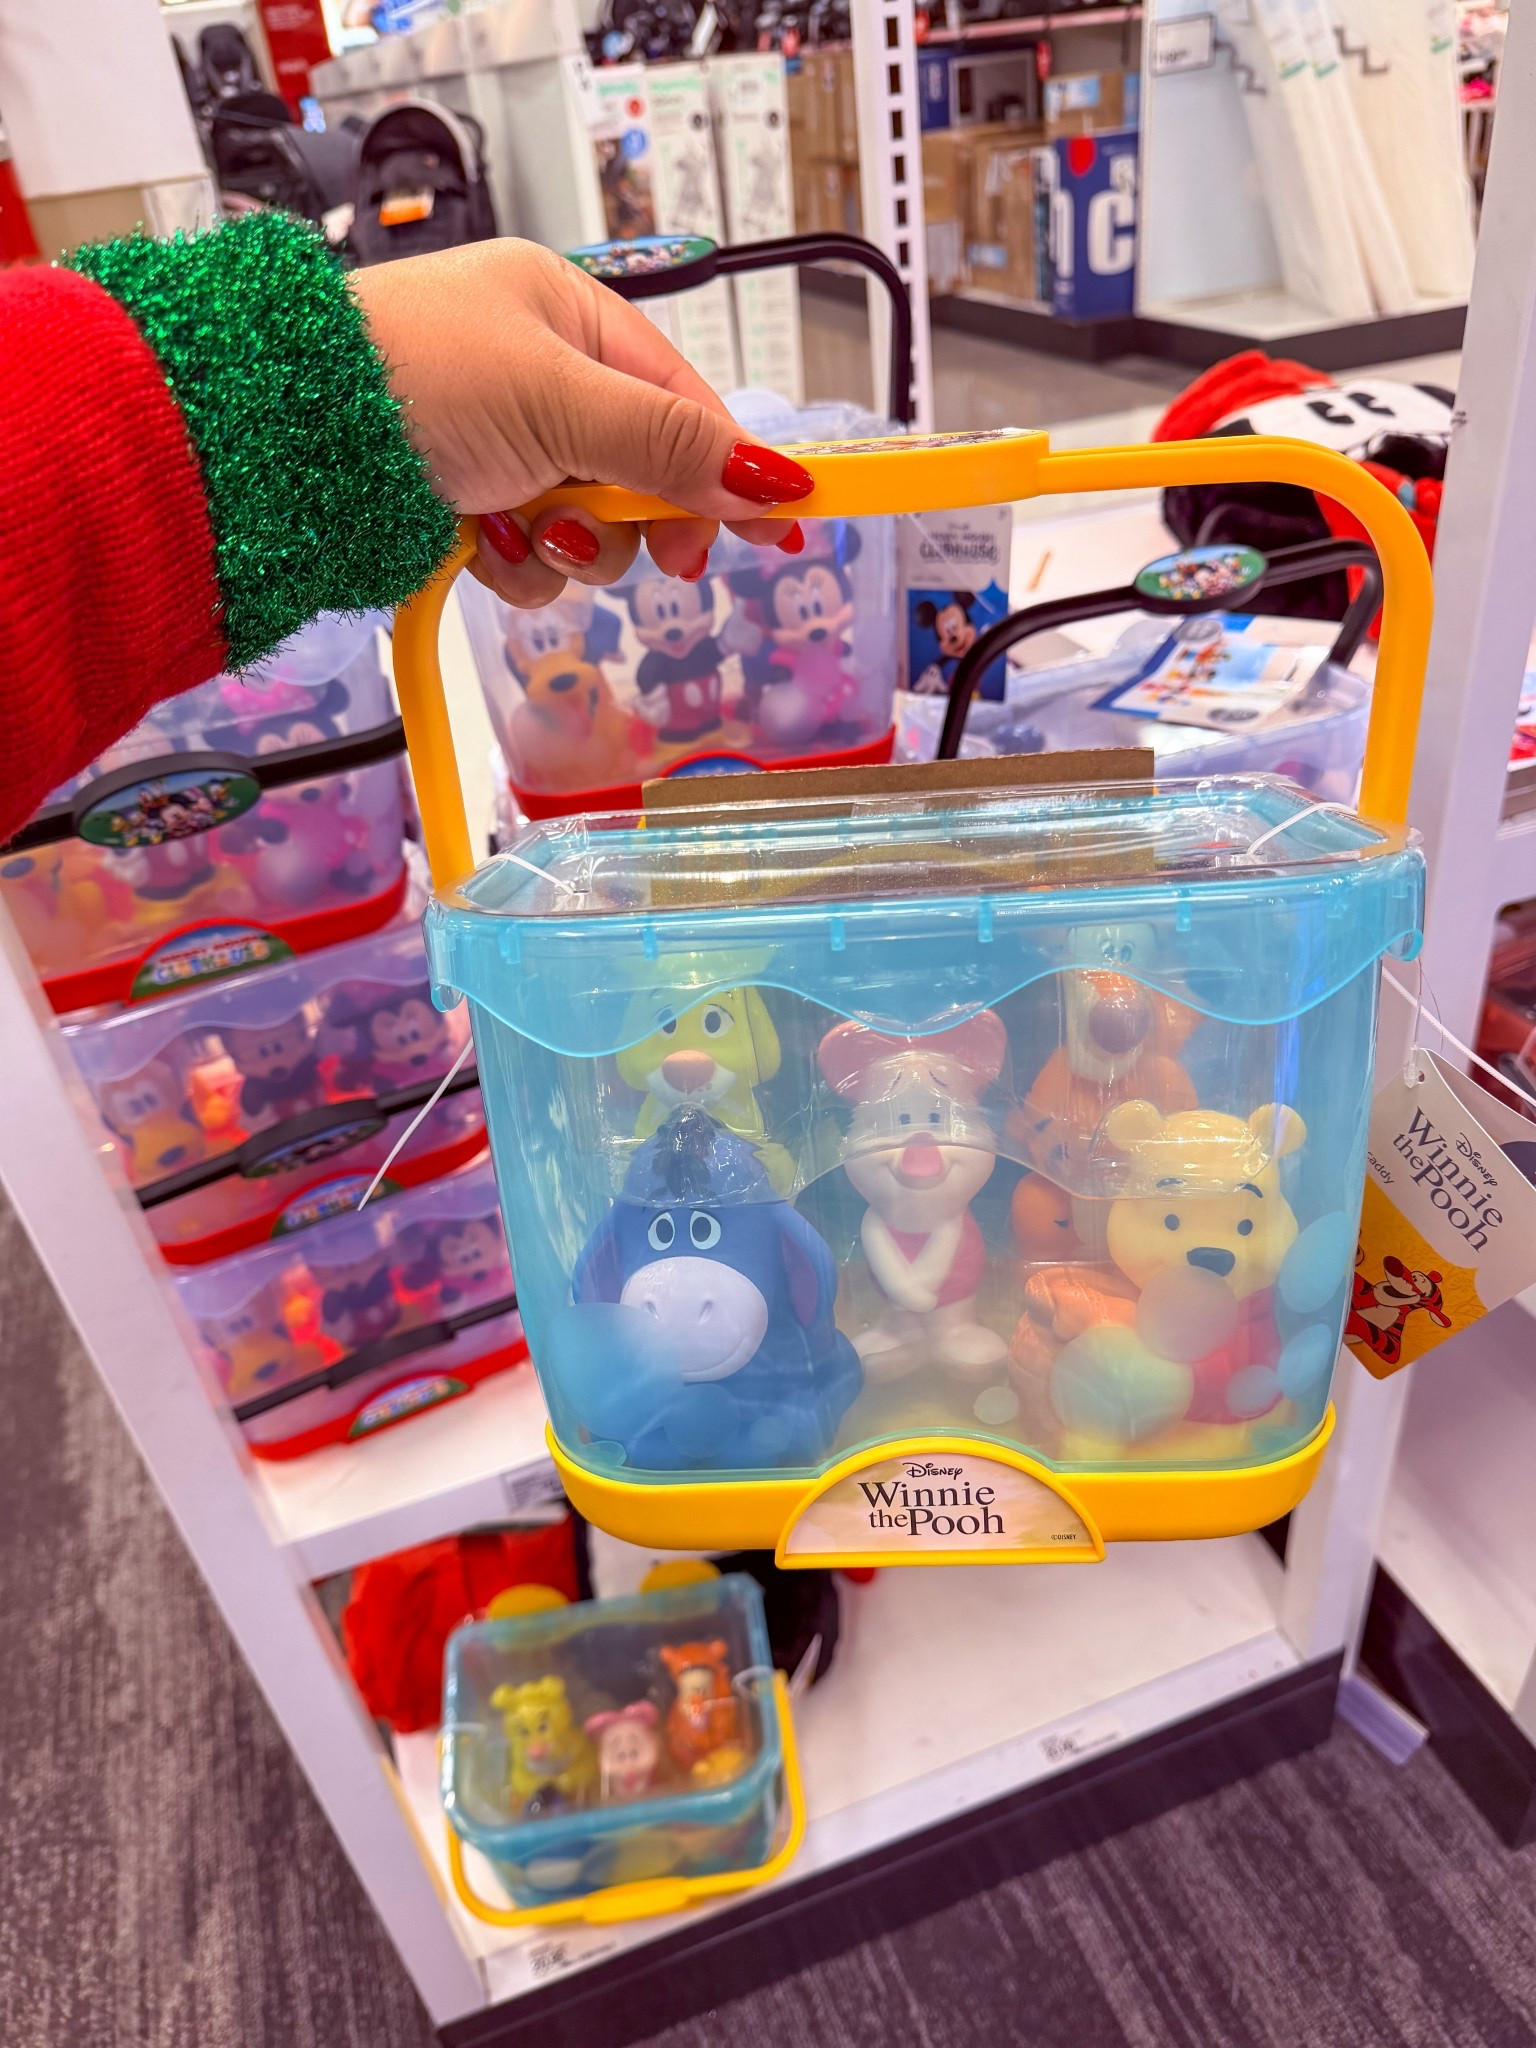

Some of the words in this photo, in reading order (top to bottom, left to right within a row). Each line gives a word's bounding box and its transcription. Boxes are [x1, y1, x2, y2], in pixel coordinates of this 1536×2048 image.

[1393, 1133, 1425, 1171] the
[1410, 1160, 1489, 1253] Pooh
[1408, 1105, 1503, 1228] Winnie
[858, 1481, 996, 1509] Winnie
[868, 1509, 908, 1528] the
[906, 1506, 1006, 1536] Pooh
